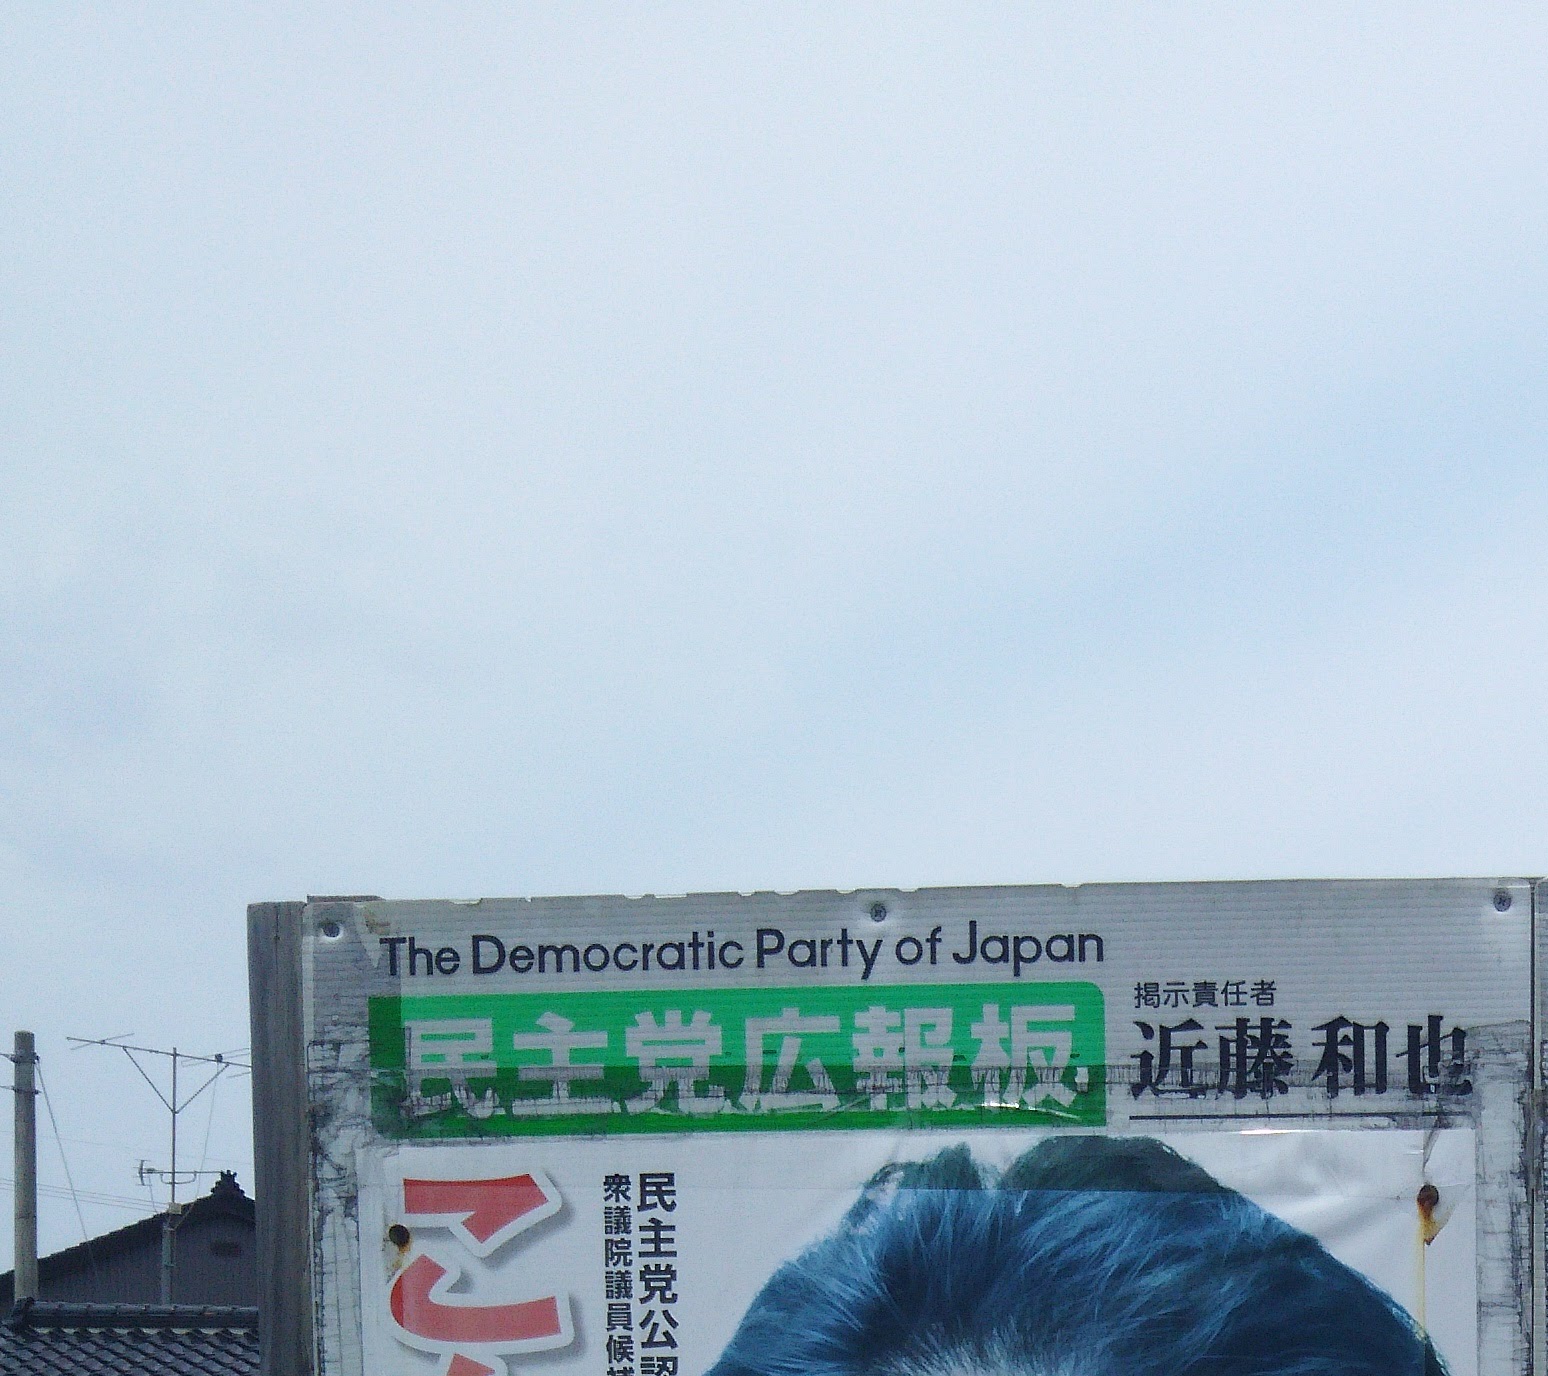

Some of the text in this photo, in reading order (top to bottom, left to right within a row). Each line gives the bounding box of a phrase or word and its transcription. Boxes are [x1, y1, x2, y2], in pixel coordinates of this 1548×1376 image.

[381, 920, 1104, 980] The Democratic Party of Japan
[1134, 980, 1277, 1008] 掲示責任者
[405, 1003, 1079, 1118] 民主党広報板
